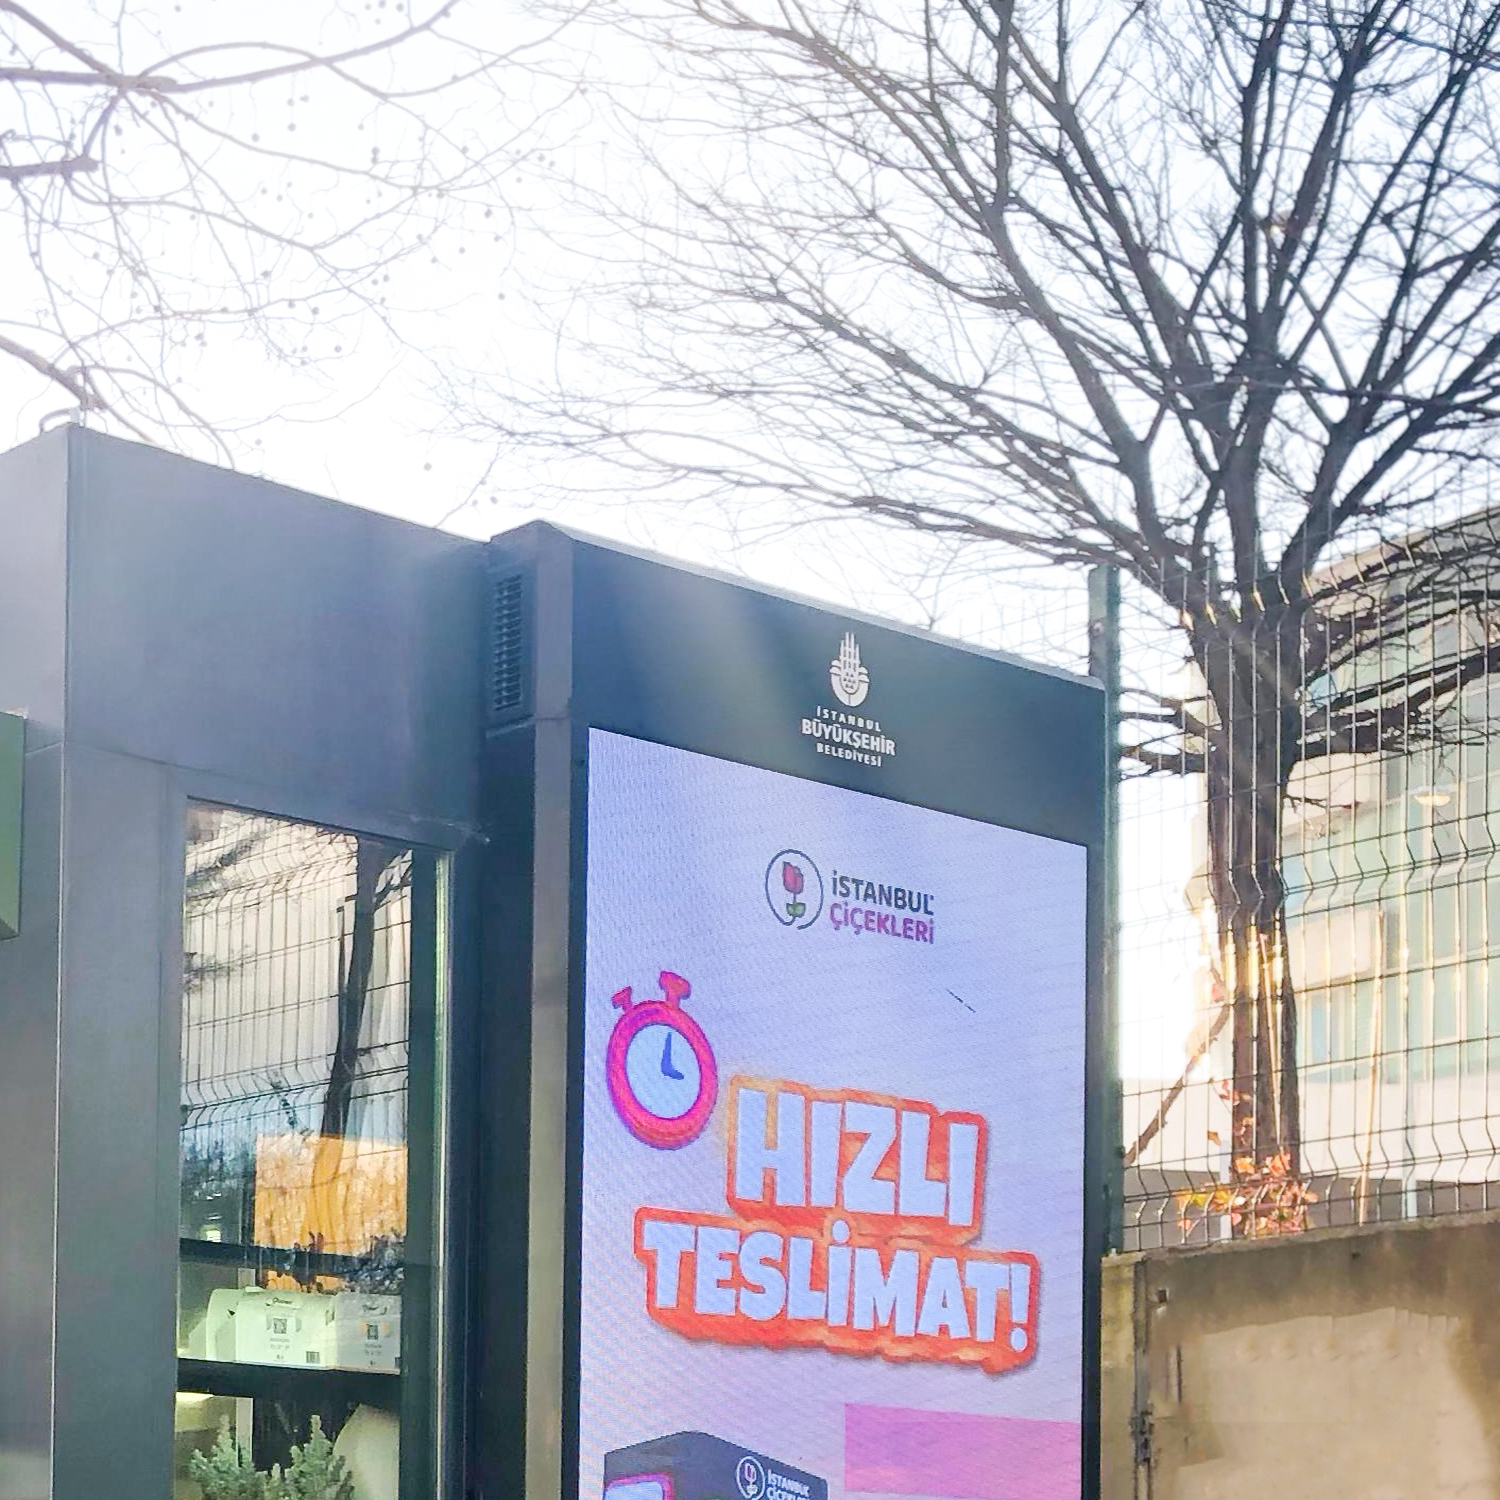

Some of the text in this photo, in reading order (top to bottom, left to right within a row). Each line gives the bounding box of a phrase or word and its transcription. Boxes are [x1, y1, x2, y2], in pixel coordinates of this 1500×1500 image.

[801, 718, 896, 756] BÜYÜKŞEHİR
[816, 705, 882, 732] İSTANBUL
[816, 742, 882, 767] BELEDİYESİ
[832, 869, 935, 916] İSTANBUL
[829, 902, 935, 945] ÇİÇEKLERİ
[734, 1087, 979, 1227] HIZLI
[642, 1218, 1031, 1353] TESLİMAT!
